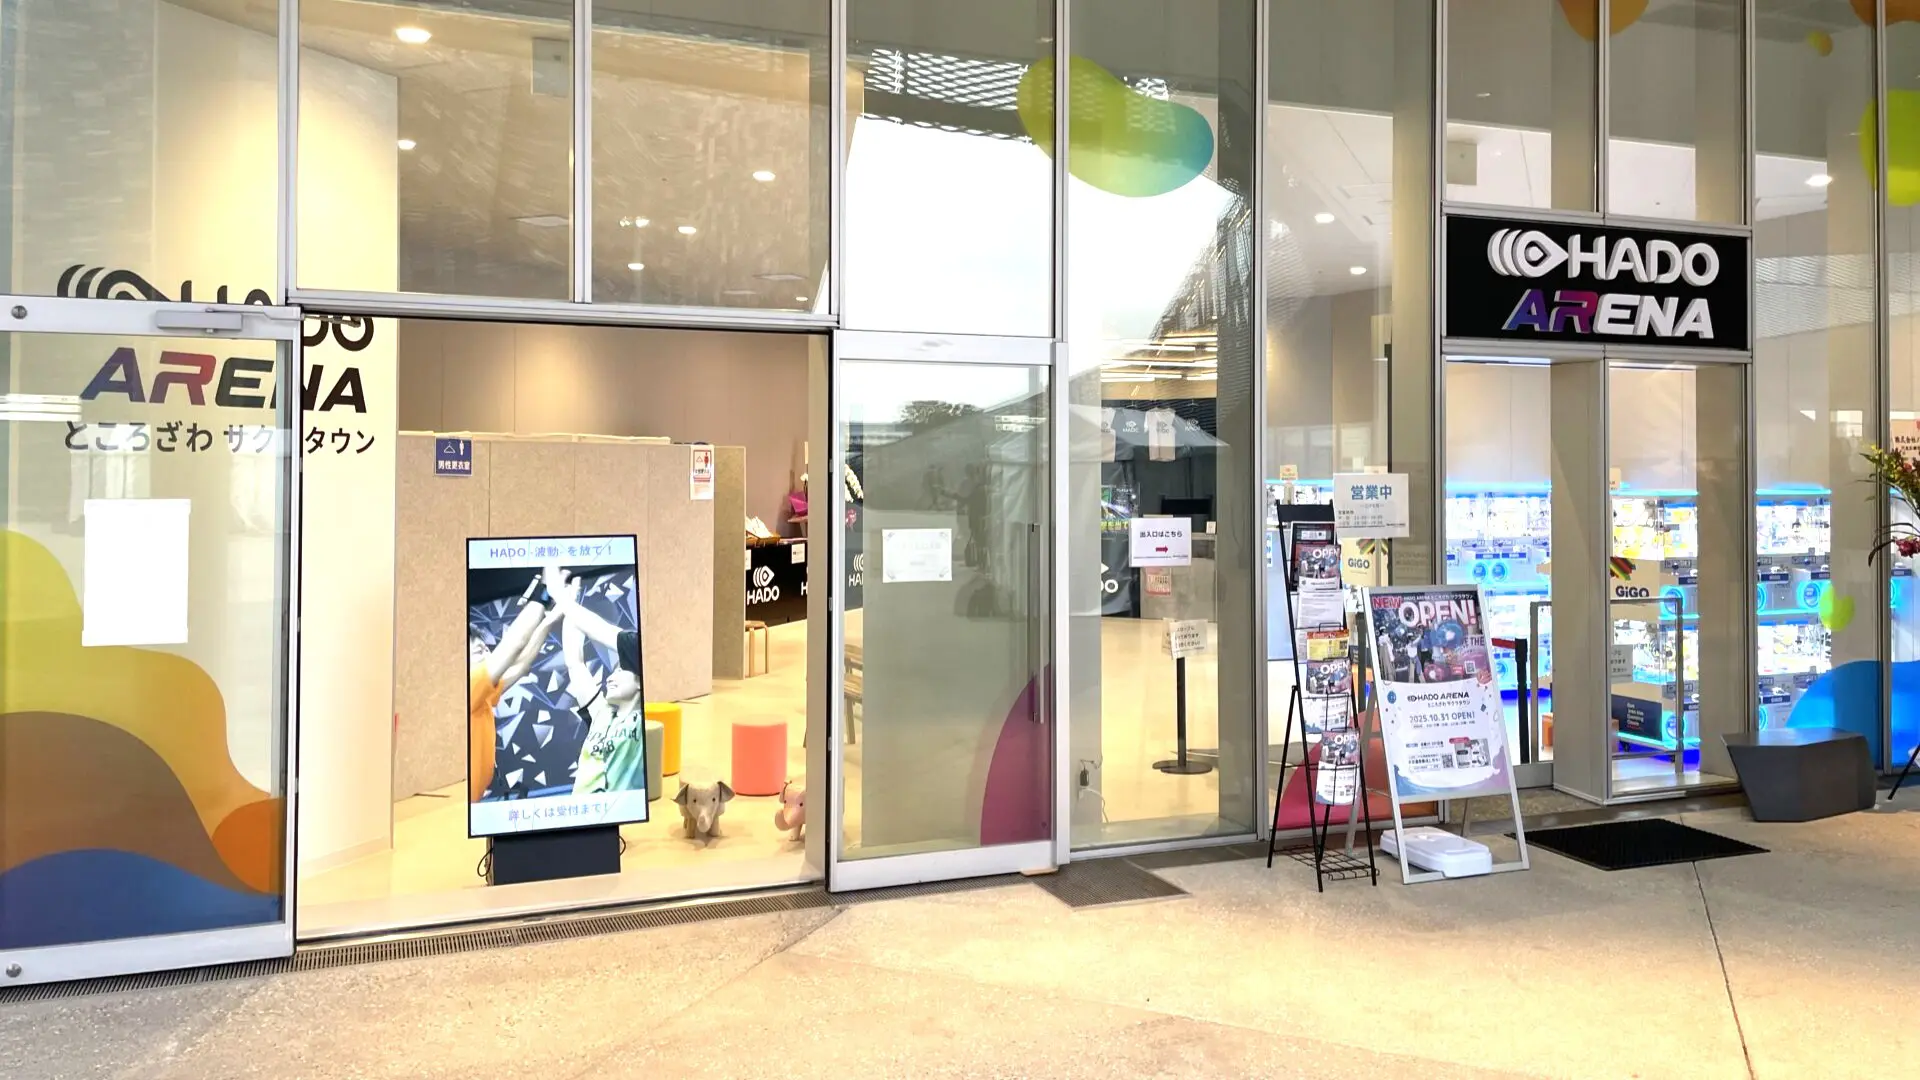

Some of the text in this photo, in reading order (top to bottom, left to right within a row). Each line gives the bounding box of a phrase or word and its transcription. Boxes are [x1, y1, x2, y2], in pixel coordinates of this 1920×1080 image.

[1567, 230, 1720, 286] HADO
[1501, 289, 1714, 339] ARENA
[64, 420, 375, 454] ところざわ サクタウン
[1351, 484, 1392, 501] 営業中
[1140, 530, 1183, 538] 出入口はこちら
[490, 547, 526, 558] HADO
[1348, 558, 1370, 569] GiGO
[747, 586, 780, 605] HADO
[1615, 585, 1649, 598] GiGO
[1372, 595, 1477, 628] NEW OPEN!
[1440, 691, 1470, 700] ARENA
[1410, 713, 1449, 723] 2025.10.31
